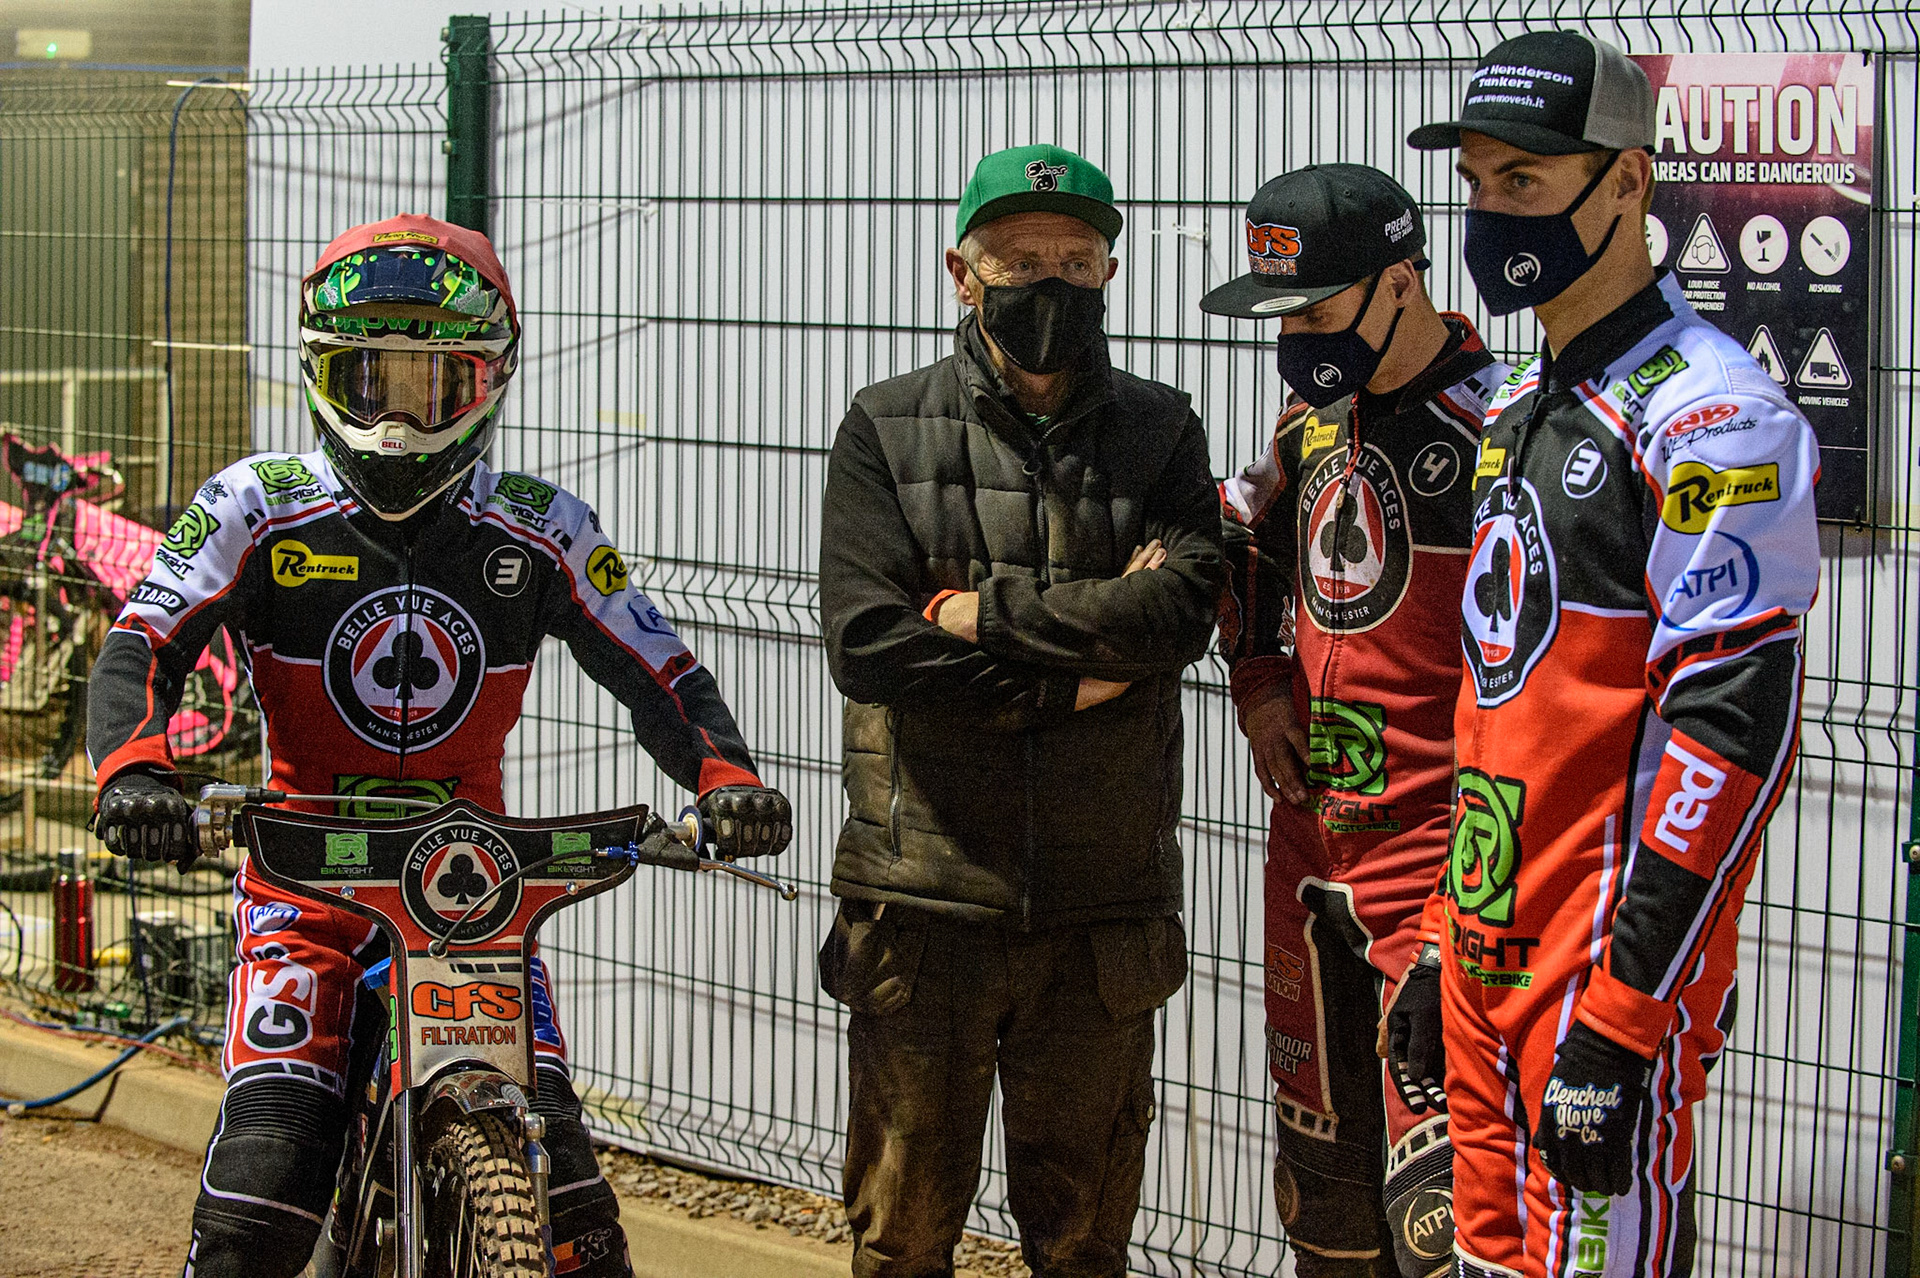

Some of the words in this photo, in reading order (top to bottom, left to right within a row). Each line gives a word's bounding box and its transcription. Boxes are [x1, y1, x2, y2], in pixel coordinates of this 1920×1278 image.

[1478, 76, 1534, 89] Tankers
[1490, 64, 1574, 85] Henderson
[1655, 85, 1858, 155] AUTION
[1700, 161, 1731, 182] CAN
[1735, 162, 1756, 183] BE
[1759, 162, 1856, 184] DANGEROUS
[1512, 259, 1534, 281] ATPI
[1687, 280, 1702, 290] LOUD
[1703, 280, 1721, 290] NOISE
[1692, 291, 1727, 301] PROTECTION
[1746, 282, 1756, 291] NO
[1757, 282, 1782, 292] ALCOHOL
[1808, 284, 1818, 293] NO
[1818, 284, 1843, 294] SMOKING
[1687, 301, 1725, 311] COMMENDED
[316, 357, 325, 391] OAKLEY
[1319, 368, 1336, 384] ATPI
[1798, 396, 1822, 406] MOVING
[1823, 397, 1849, 408] VEHICLES
[381, 440, 404, 450] BELL
[1304, 425, 1336, 448] Rentruck
[1421, 452, 1450, 483] 4
[1479, 459, 1501, 469] ntruck
[1567, 449, 1602, 487] 3
[1303, 457, 1340, 513] BELLE
[1378, 478, 1401, 531] ACES
[1668, 475, 1773, 523] Rentruck
[1518, 512, 1544, 575] ACES
[277, 548, 355, 578] Rentruck
[495, 558, 523, 585] 3
[1669, 558, 1738, 602] ATPI
[131, 585, 181, 608] TARD
[337, 601, 387, 650] BELLE
[395, 594, 435, 614] VUE
[439, 611, 476, 656] ACES
[1654, 740, 1727, 853] red
[1330, 822, 1400, 832] MOTORBIKE
[410, 833, 446, 871] BELLE
[450, 828, 479, 842] VUE
[484, 837, 513, 871] ACES
[320, 866, 374, 875] BIKERIGHT
[546, 865, 597, 873] BIKERIGHT
[255, 905, 288, 920] ATPI
[411, 981, 523, 1021] CFS
[421, 1025, 517, 1046] FILTRATION
[1275, 1031, 1312, 1060] DOOR
[1544, 1078, 1621, 1109] Clenched
[1556, 1103, 1605, 1139] glove
